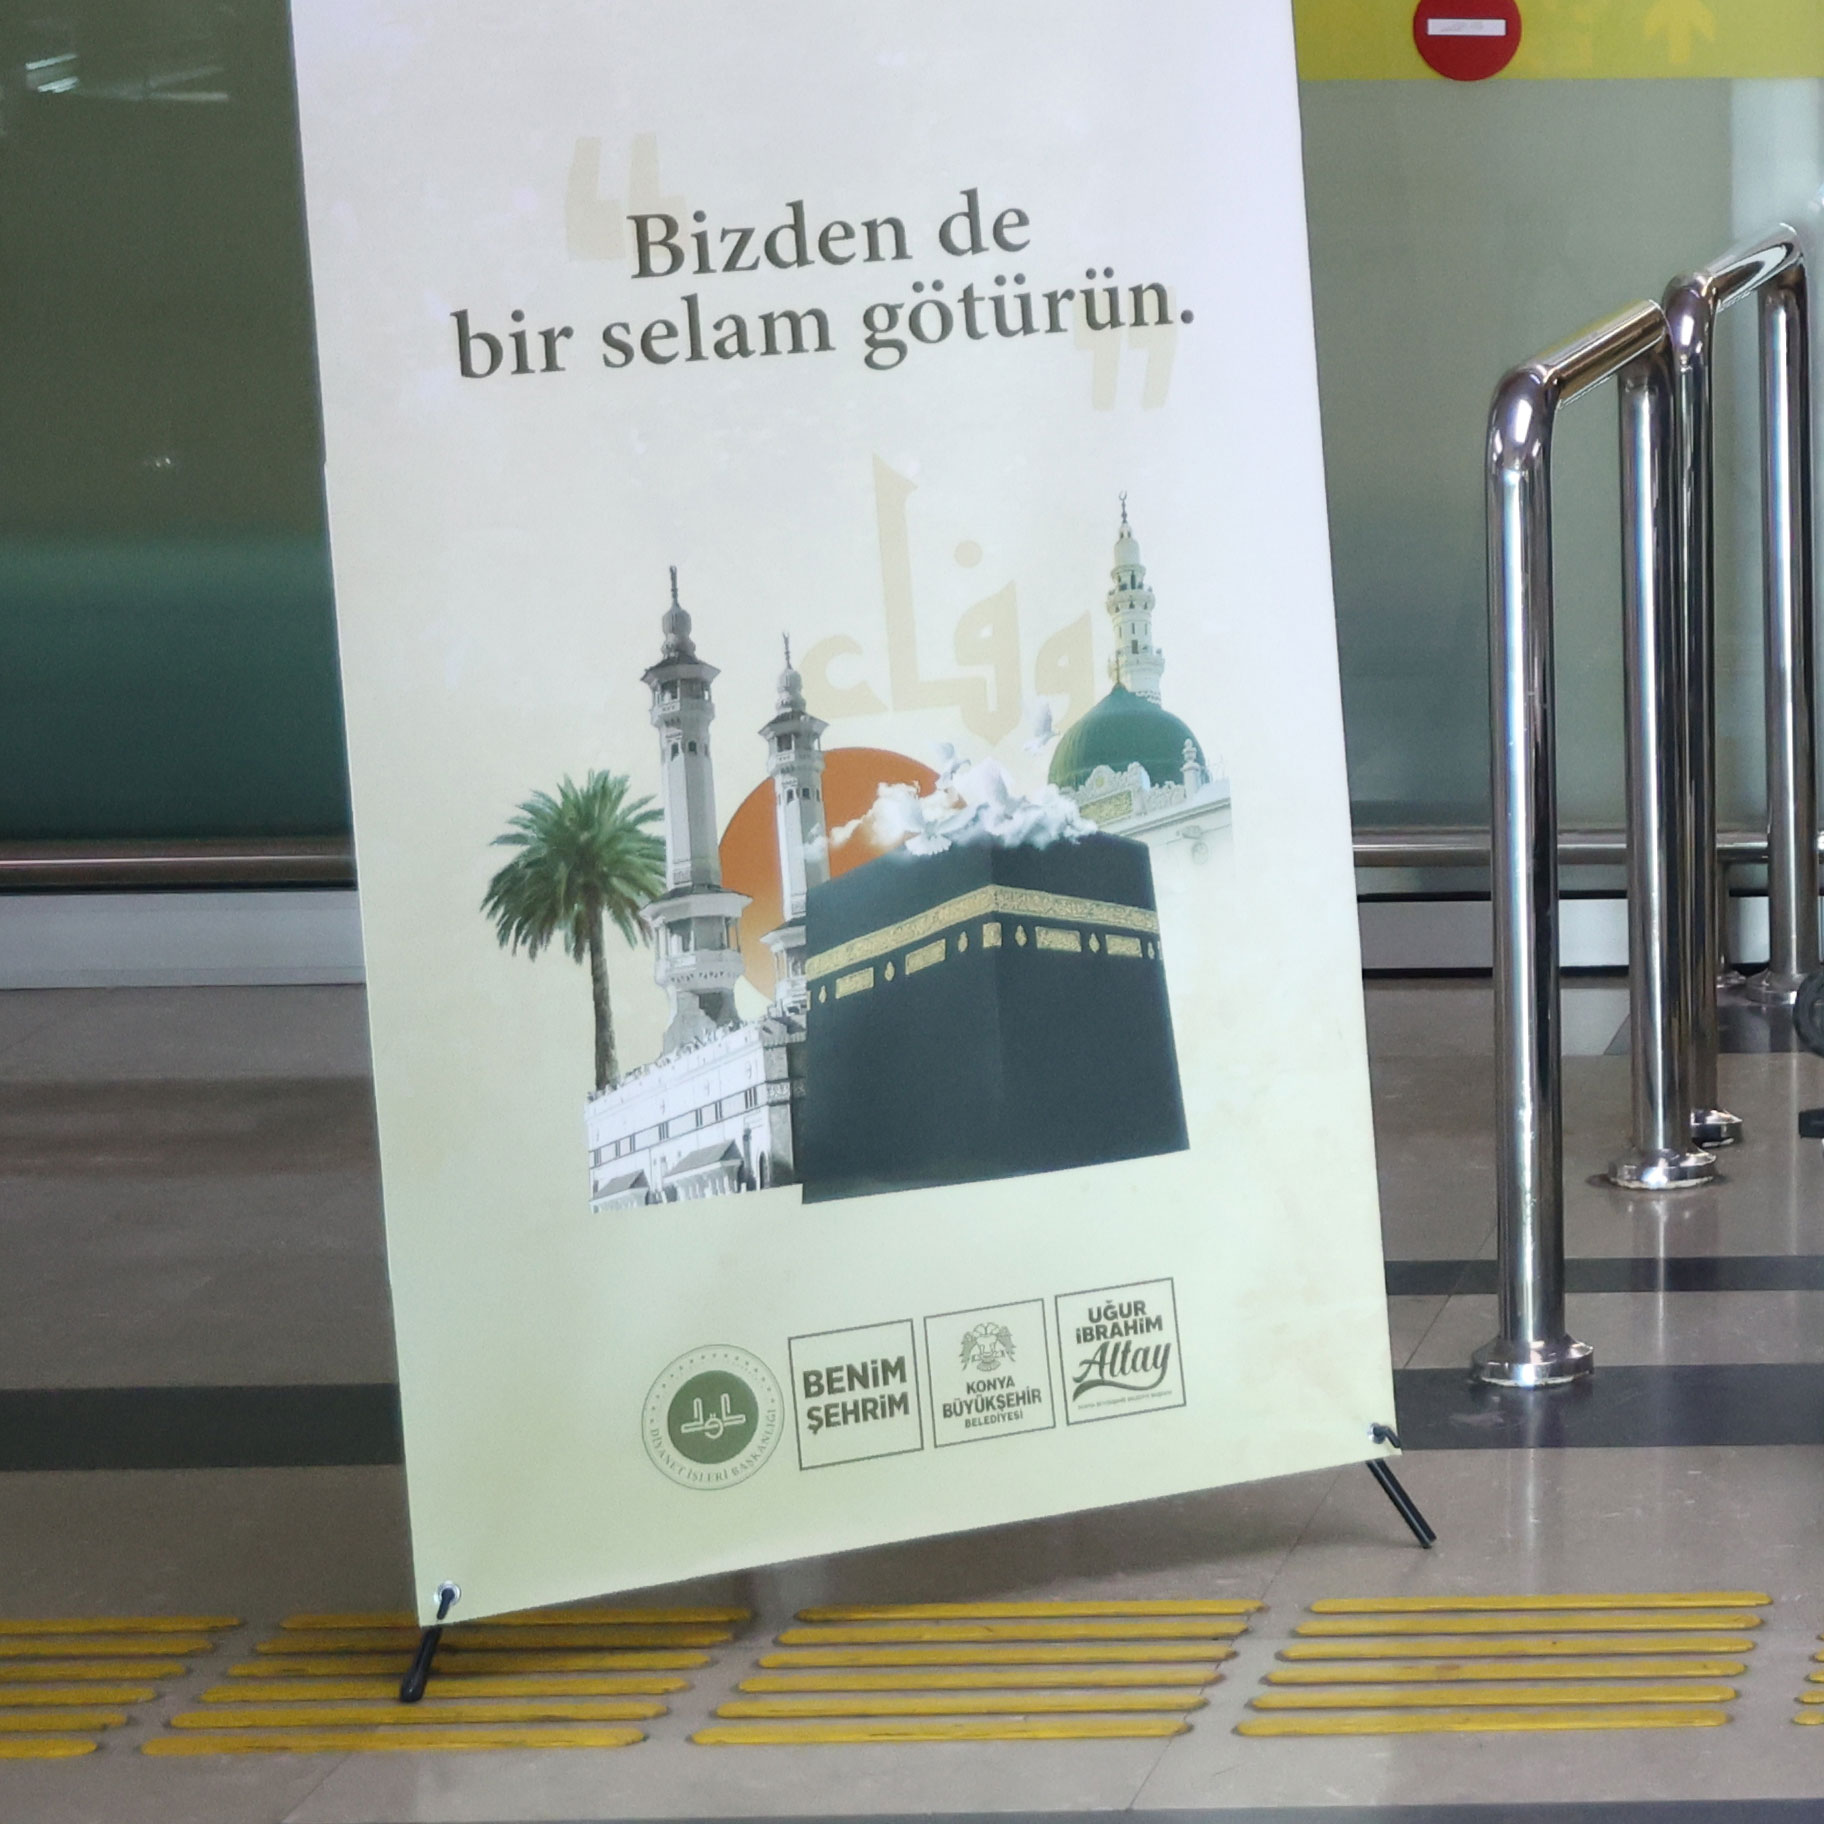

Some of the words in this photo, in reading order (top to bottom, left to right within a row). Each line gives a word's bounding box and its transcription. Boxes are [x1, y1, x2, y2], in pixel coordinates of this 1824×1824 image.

[627, 198, 913, 280] Bizden
[937, 187, 1032, 260] de
[450, 307, 574, 379] bir
[600, 290, 835, 370] selam
[861, 264, 1196, 371] götürün.
[1075, 1314, 1164, 1345] İBRAHİM
[1087, 1298, 1147, 1324] UĞUR
[802, 1354, 908, 1400] BENİM
[965, 1375, 1016, 1395] KONYA
[1073, 1340, 1173, 1392] Altay
[806, 1390, 911, 1436] ŞEHRİM
[942, 1385, 1043, 1420] BÜYÜKŞEHİR
[964, 1410, 1024, 1429] BELEDİYESİ
